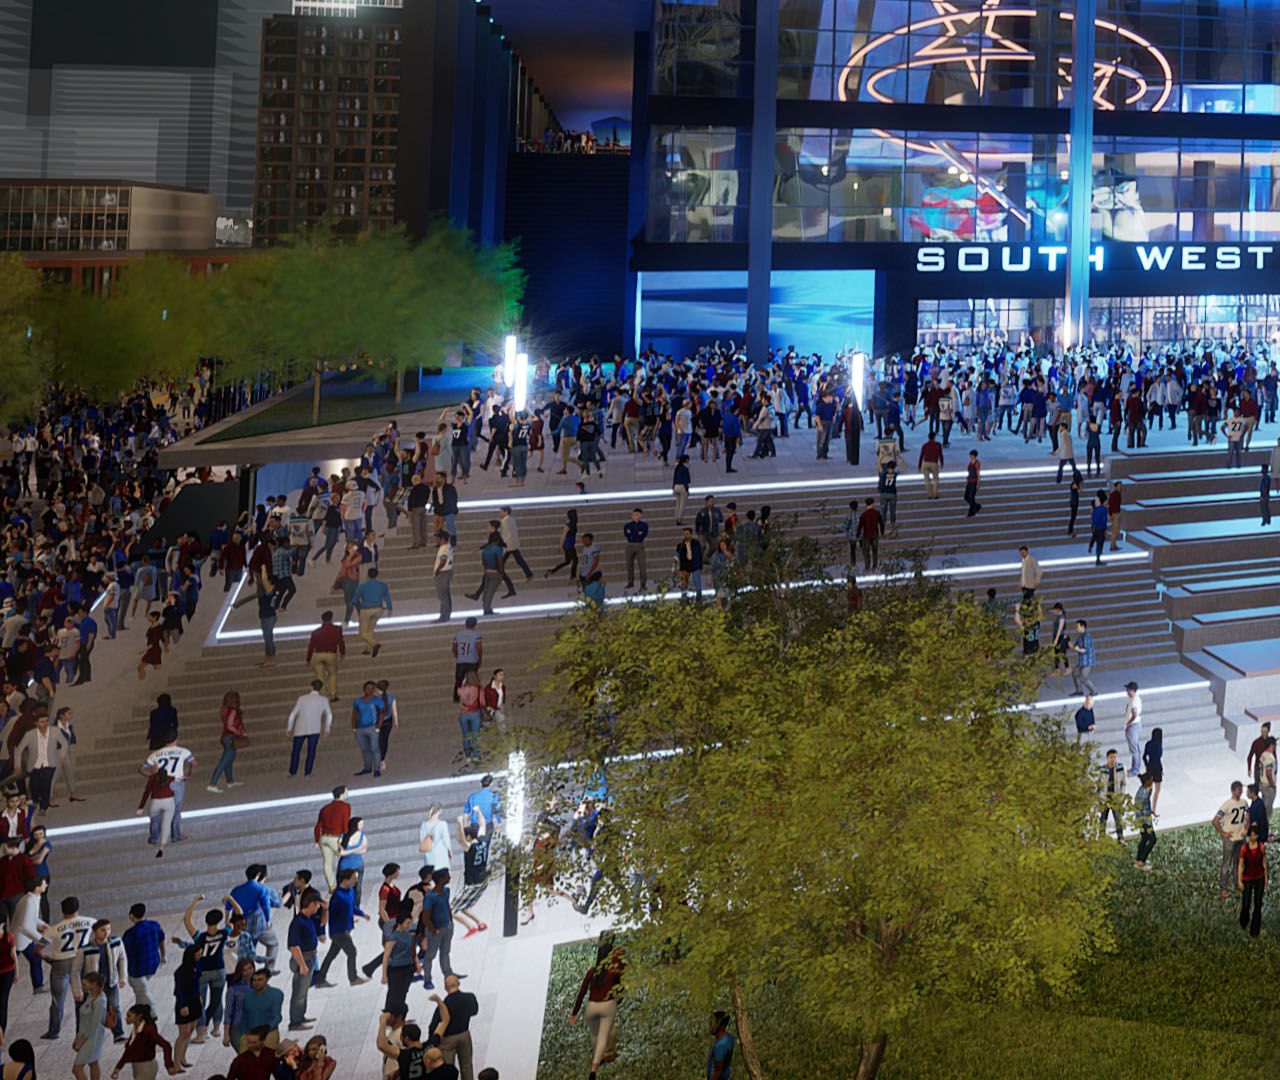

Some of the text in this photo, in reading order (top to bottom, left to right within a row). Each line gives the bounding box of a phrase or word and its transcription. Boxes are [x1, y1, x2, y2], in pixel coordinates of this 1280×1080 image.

[1136, 246, 1273, 270] WEST
[61, 928, 90, 952] 27
[203, 942, 221, 956] 17
